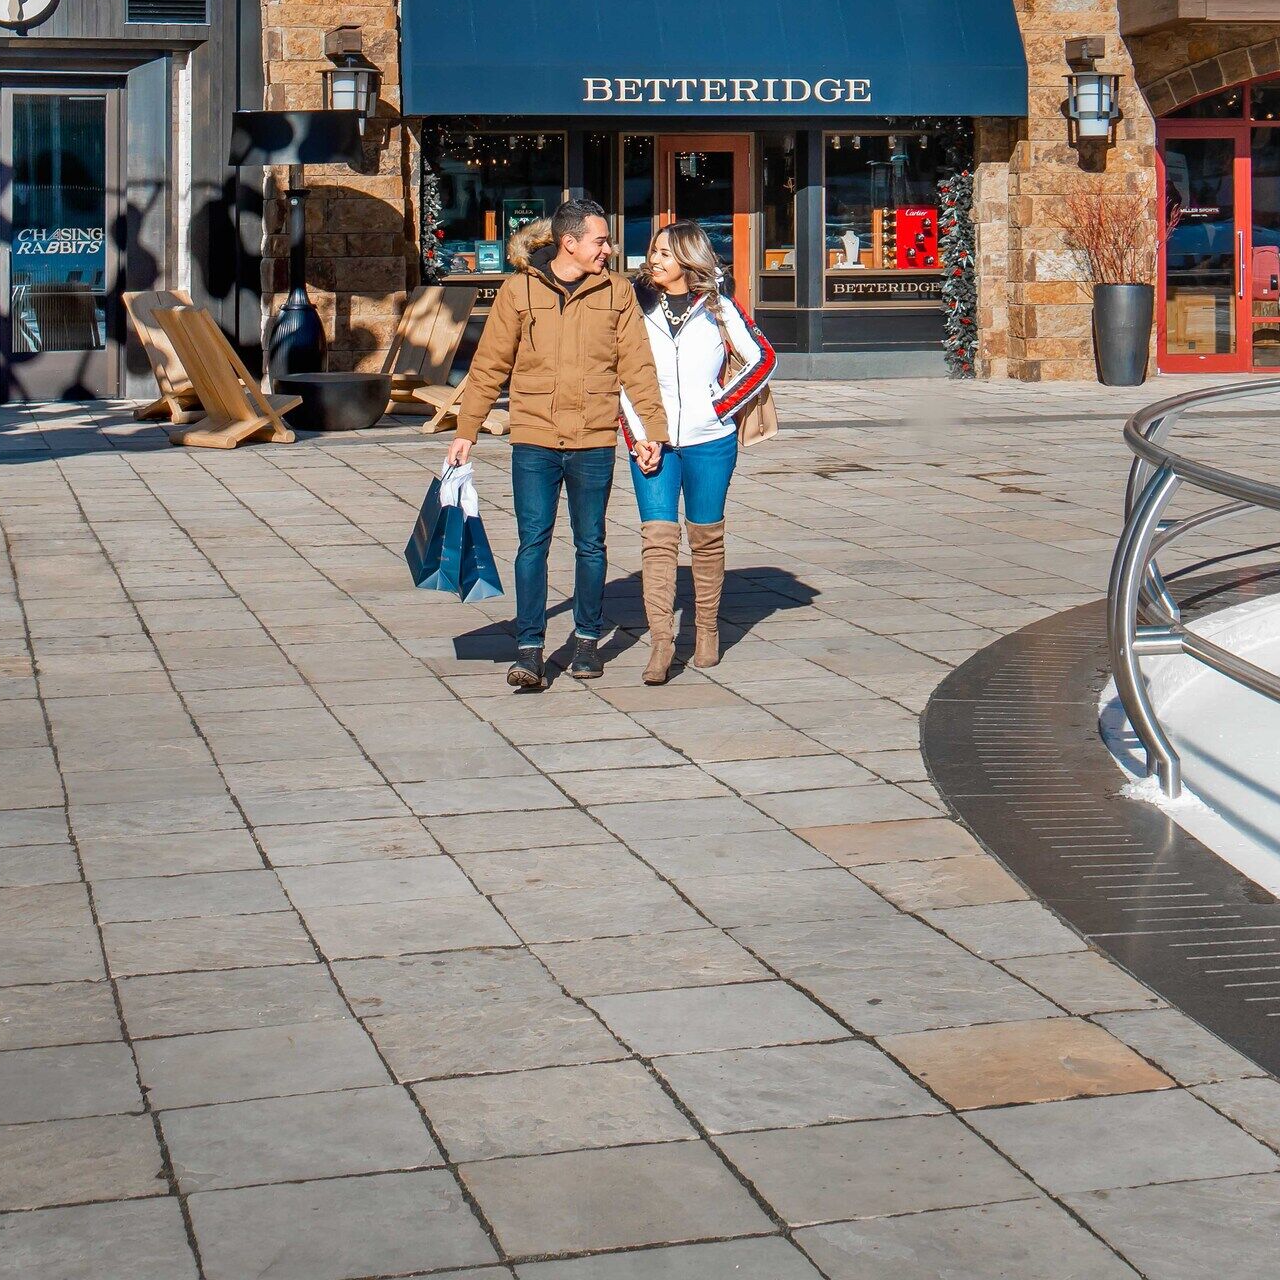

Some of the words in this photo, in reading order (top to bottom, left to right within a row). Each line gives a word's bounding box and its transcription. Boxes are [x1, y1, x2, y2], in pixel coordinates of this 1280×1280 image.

[582, 77, 872, 103] BETTERIDGE
[905, 208, 929, 217] Cartier
[17, 227, 103, 242] CHASING
[16, 240, 103, 255] RABBITS
[833, 282, 941, 294] BETTERIDGE
